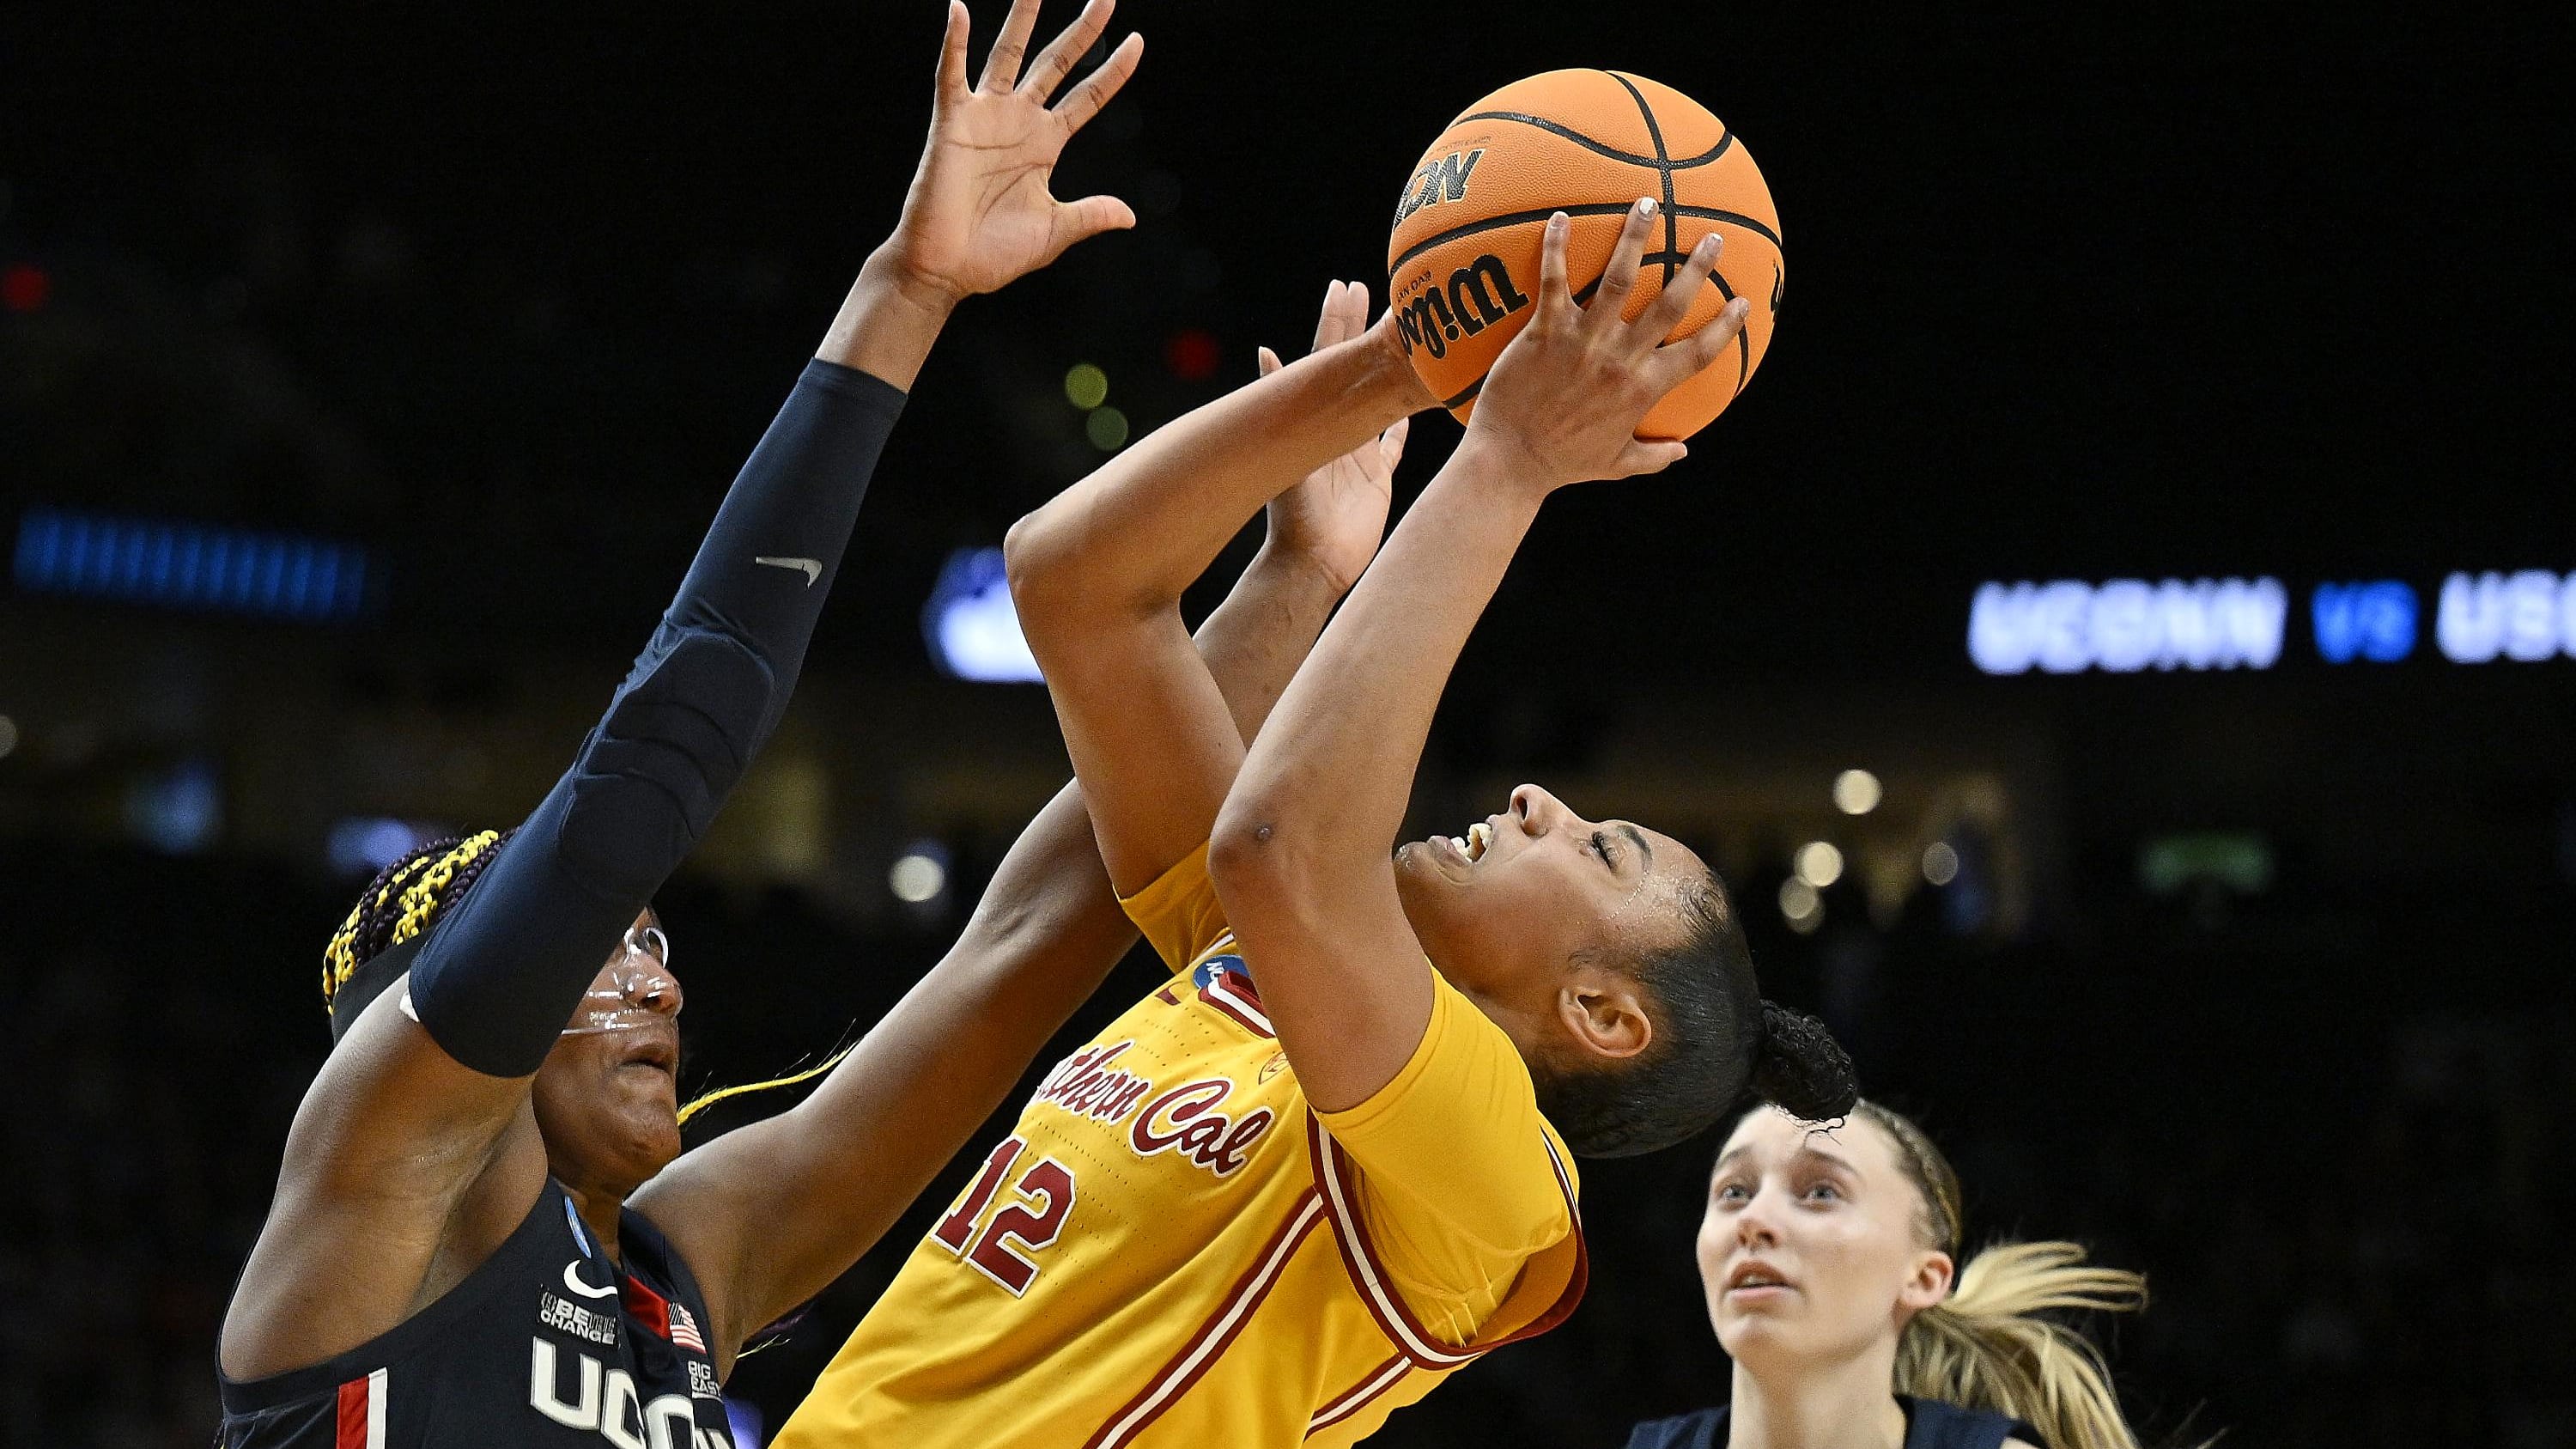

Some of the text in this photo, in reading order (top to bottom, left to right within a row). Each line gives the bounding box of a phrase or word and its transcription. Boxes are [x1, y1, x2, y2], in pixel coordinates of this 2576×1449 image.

[1969, 569, 2576, 674] UCONN VS US
[1131, 1079, 1274, 1178] Cal
[931, 1135, 1077, 1299] 12
[688, 1361, 711, 1380] BIG
